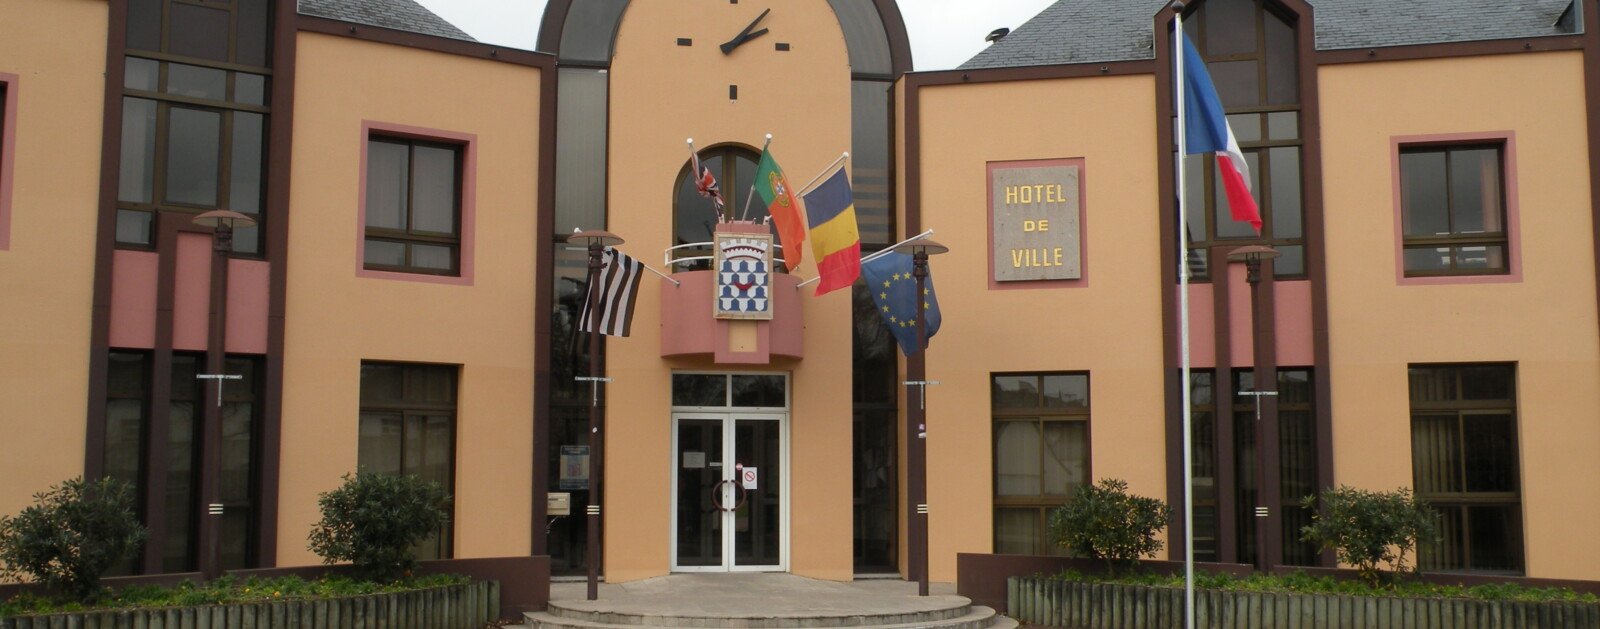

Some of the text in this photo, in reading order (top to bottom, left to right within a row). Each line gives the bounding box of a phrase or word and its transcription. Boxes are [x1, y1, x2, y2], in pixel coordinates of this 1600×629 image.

[1006, 184, 1065, 204] HOTEL
[1023, 219, 1049, 232] DE
[1012, 247, 1063, 268] VILLE
